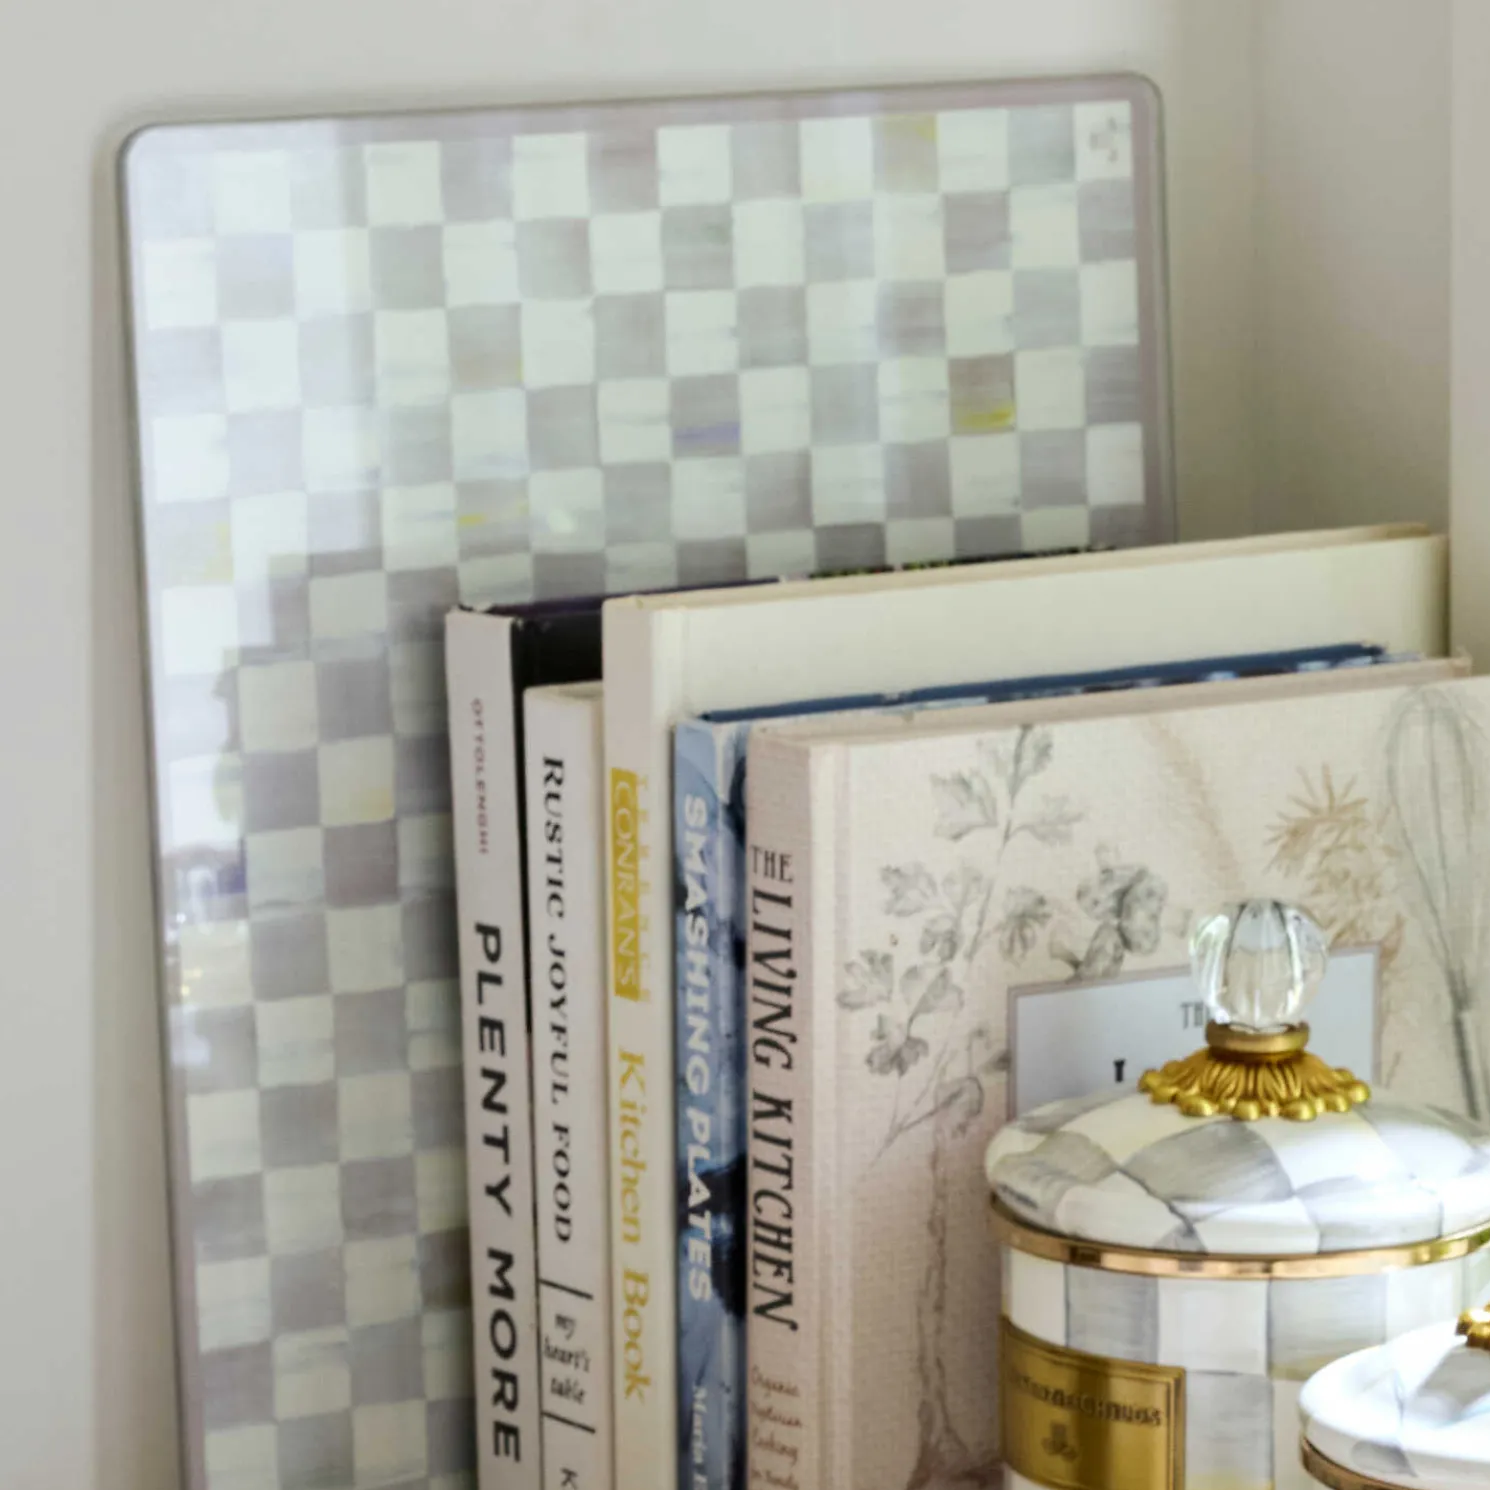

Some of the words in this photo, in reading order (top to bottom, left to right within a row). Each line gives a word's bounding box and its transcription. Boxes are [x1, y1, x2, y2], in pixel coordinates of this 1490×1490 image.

[542, 755, 565, 919] RUSTIC
[750, 845, 795, 884] THE
[548, 932, 570, 1105] JOYFUL
[684, 793, 710, 1096] SMASHING
[751, 886, 798, 1070] LIVING
[474, 921, 514, 1219] PLENTY
[618, 1046, 647, 1245] Kitchen
[552, 1121, 573, 1244] FOOD
[686, 1107, 714, 1303] PLATES
[751, 1088, 800, 1333] KITCHEN
[486, 1246, 522, 1464] MORE
[622, 1267, 652, 1404] Book
